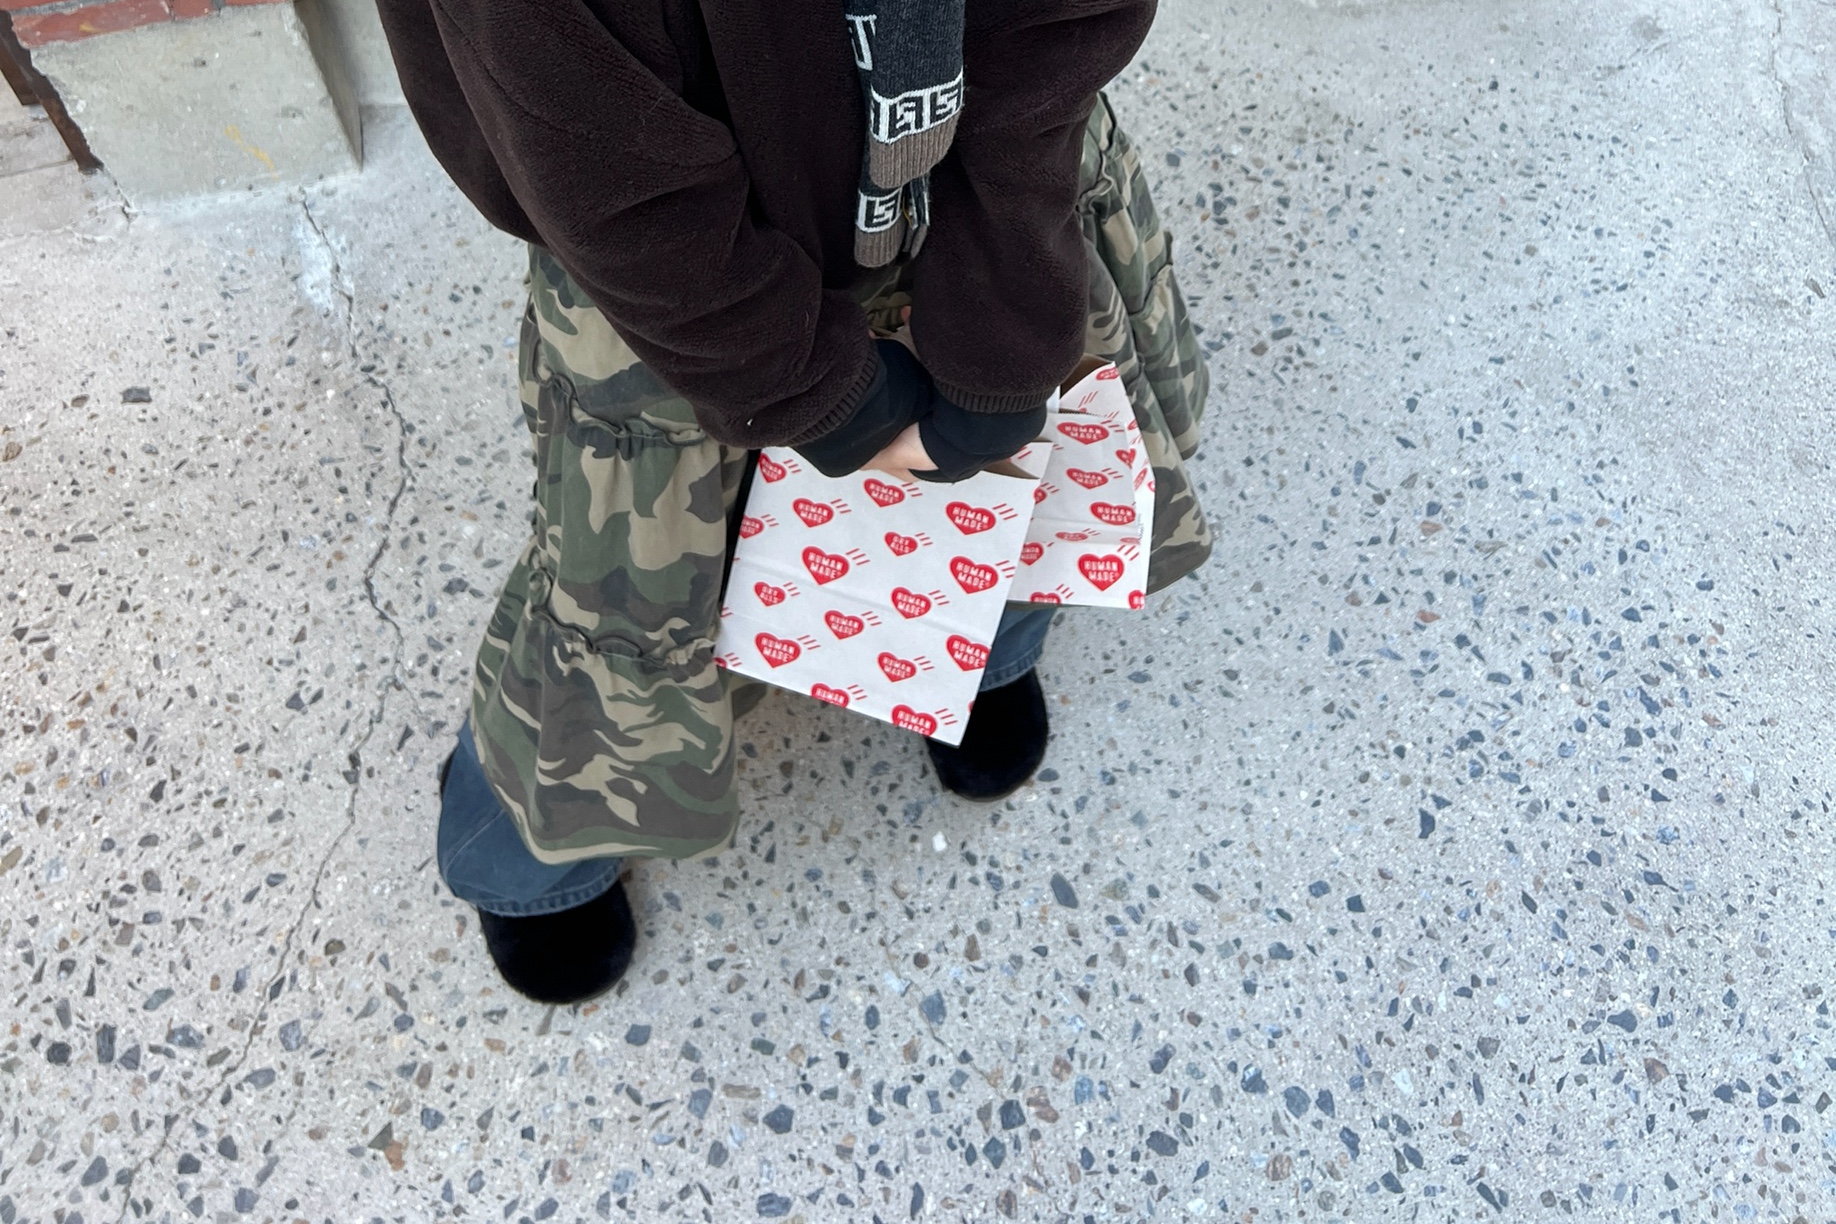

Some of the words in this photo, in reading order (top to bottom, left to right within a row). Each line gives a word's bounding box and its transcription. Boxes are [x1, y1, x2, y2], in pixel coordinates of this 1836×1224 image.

[1065, 426, 1101, 434] HUMAN
[869, 483, 899, 497] HUMAN
[798, 502, 828, 516] HUMAN
[952, 506, 989, 522] HUMAN
[1097, 506, 1132, 516] HUMAN
[808, 551, 843, 571] HUMAN
[1084, 561, 1118, 571] HUMAN
[956, 561, 992, 581] HUMAN
[896, 592, 926, 608] HUMAN
[829, 615, 859, 628] HUMAN
[761, 637, 795, 655] HUMAN
[952, 639, 987, 660] HUMAN
[882, 657, 912, 673] HUMAN
[815, 687, 845, 705] HUMAN
[898, 710, 931, 729] HUMAN
